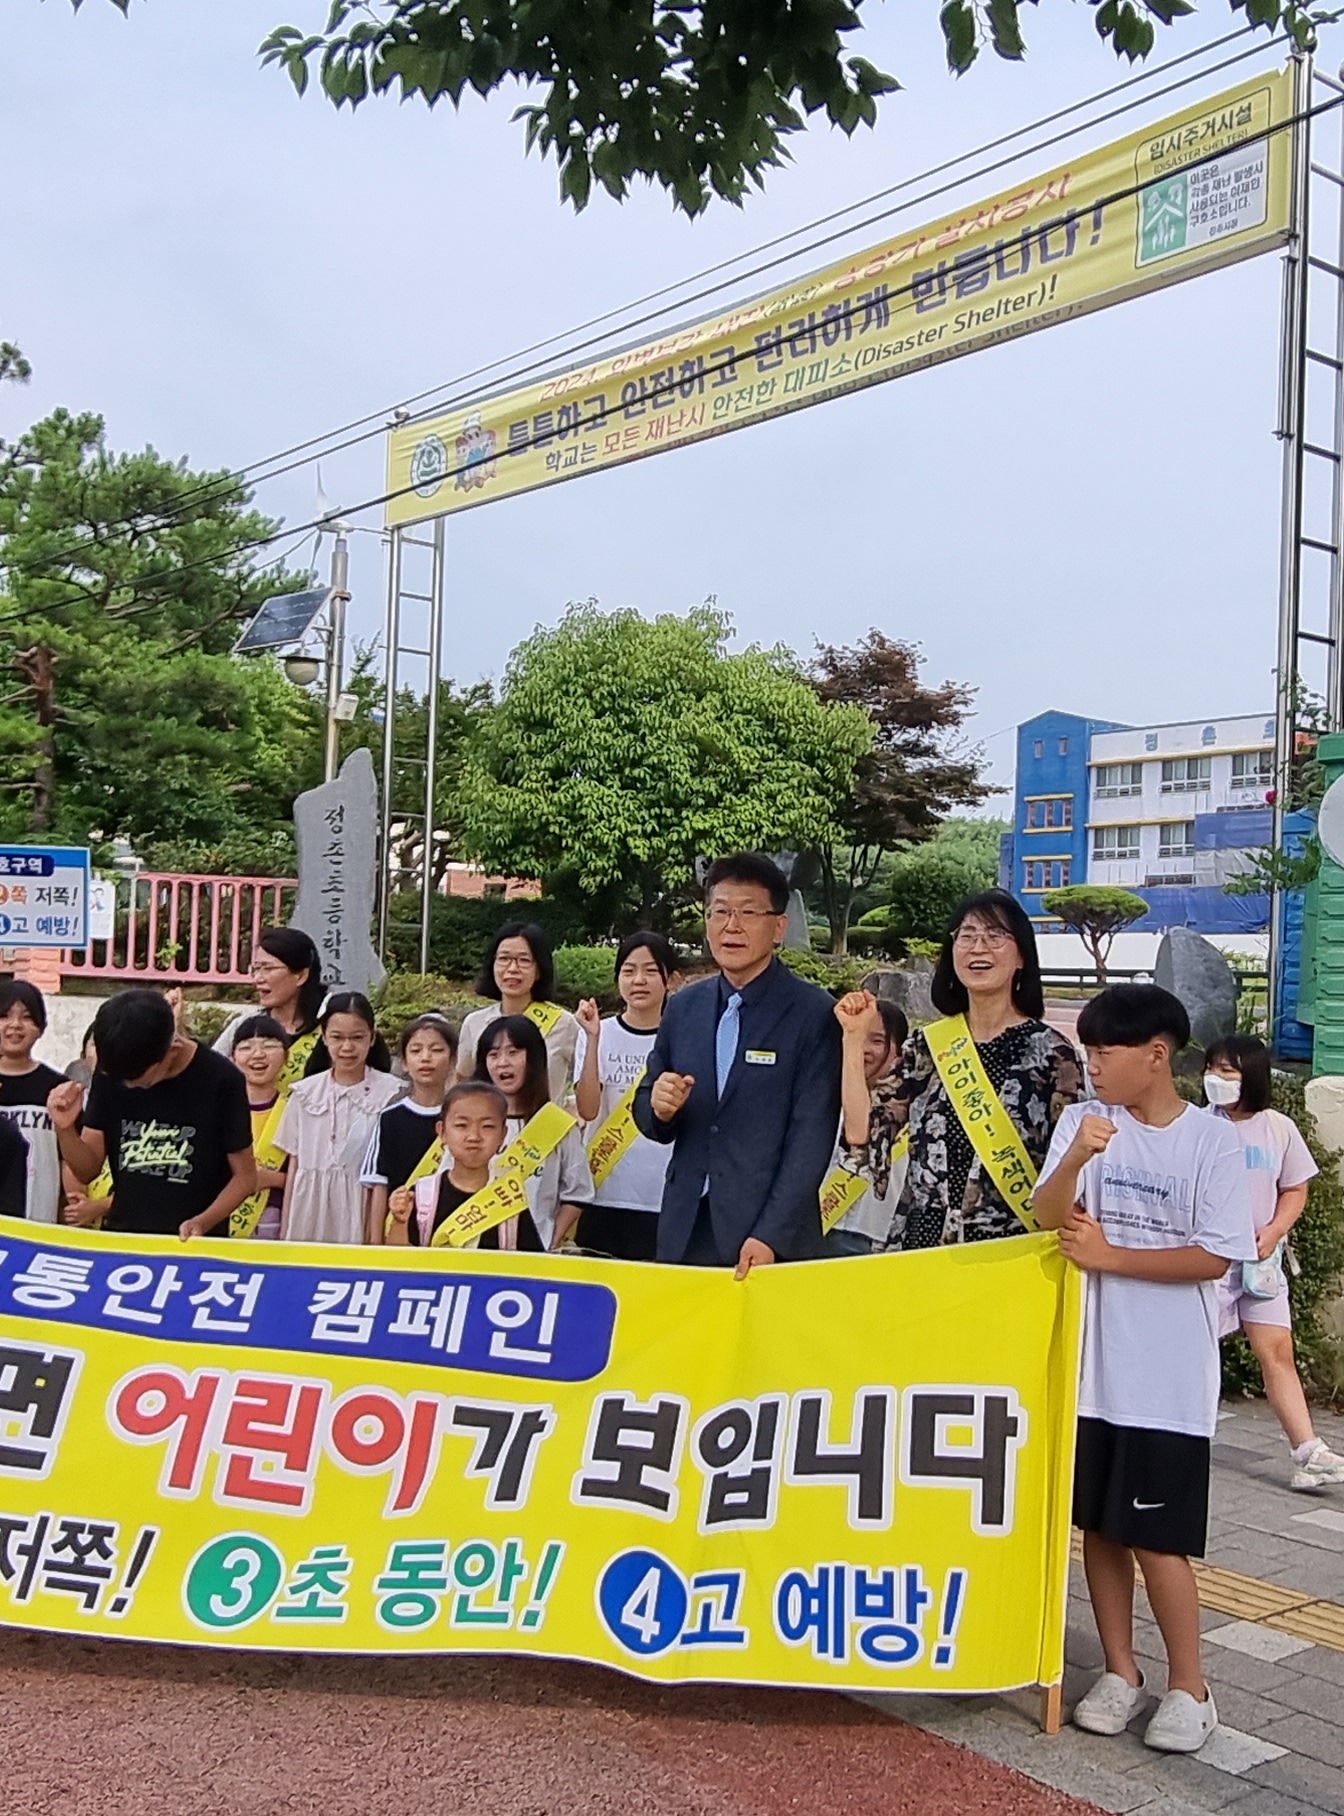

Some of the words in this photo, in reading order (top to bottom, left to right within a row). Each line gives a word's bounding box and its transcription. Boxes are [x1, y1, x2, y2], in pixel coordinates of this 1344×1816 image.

[1149, 101, 1252, 161] 임시주거시설
[544, 441, 598, 473] 학교는
[602, 424, 643, 455] 모든
[643, 401, 708, 442] 재난시
[711, 378, 778, 422] 안전한
[952, 272, 1060, 334] Shelter)!
[619, 343, 739, 421] 안전하고
[35, 885, 79, 908] 저쪽!
[36, 915, 80, 937] 예방!
[306, 1279, 561, 1364] 캠페인
[115, 1370, 551, 1513] 어린이가
[579, 1393, 1019, 1527] 보입니다
[376, 1542, 562, 1629] 동안!
[777, 1564, 964, 1666] 예방!
